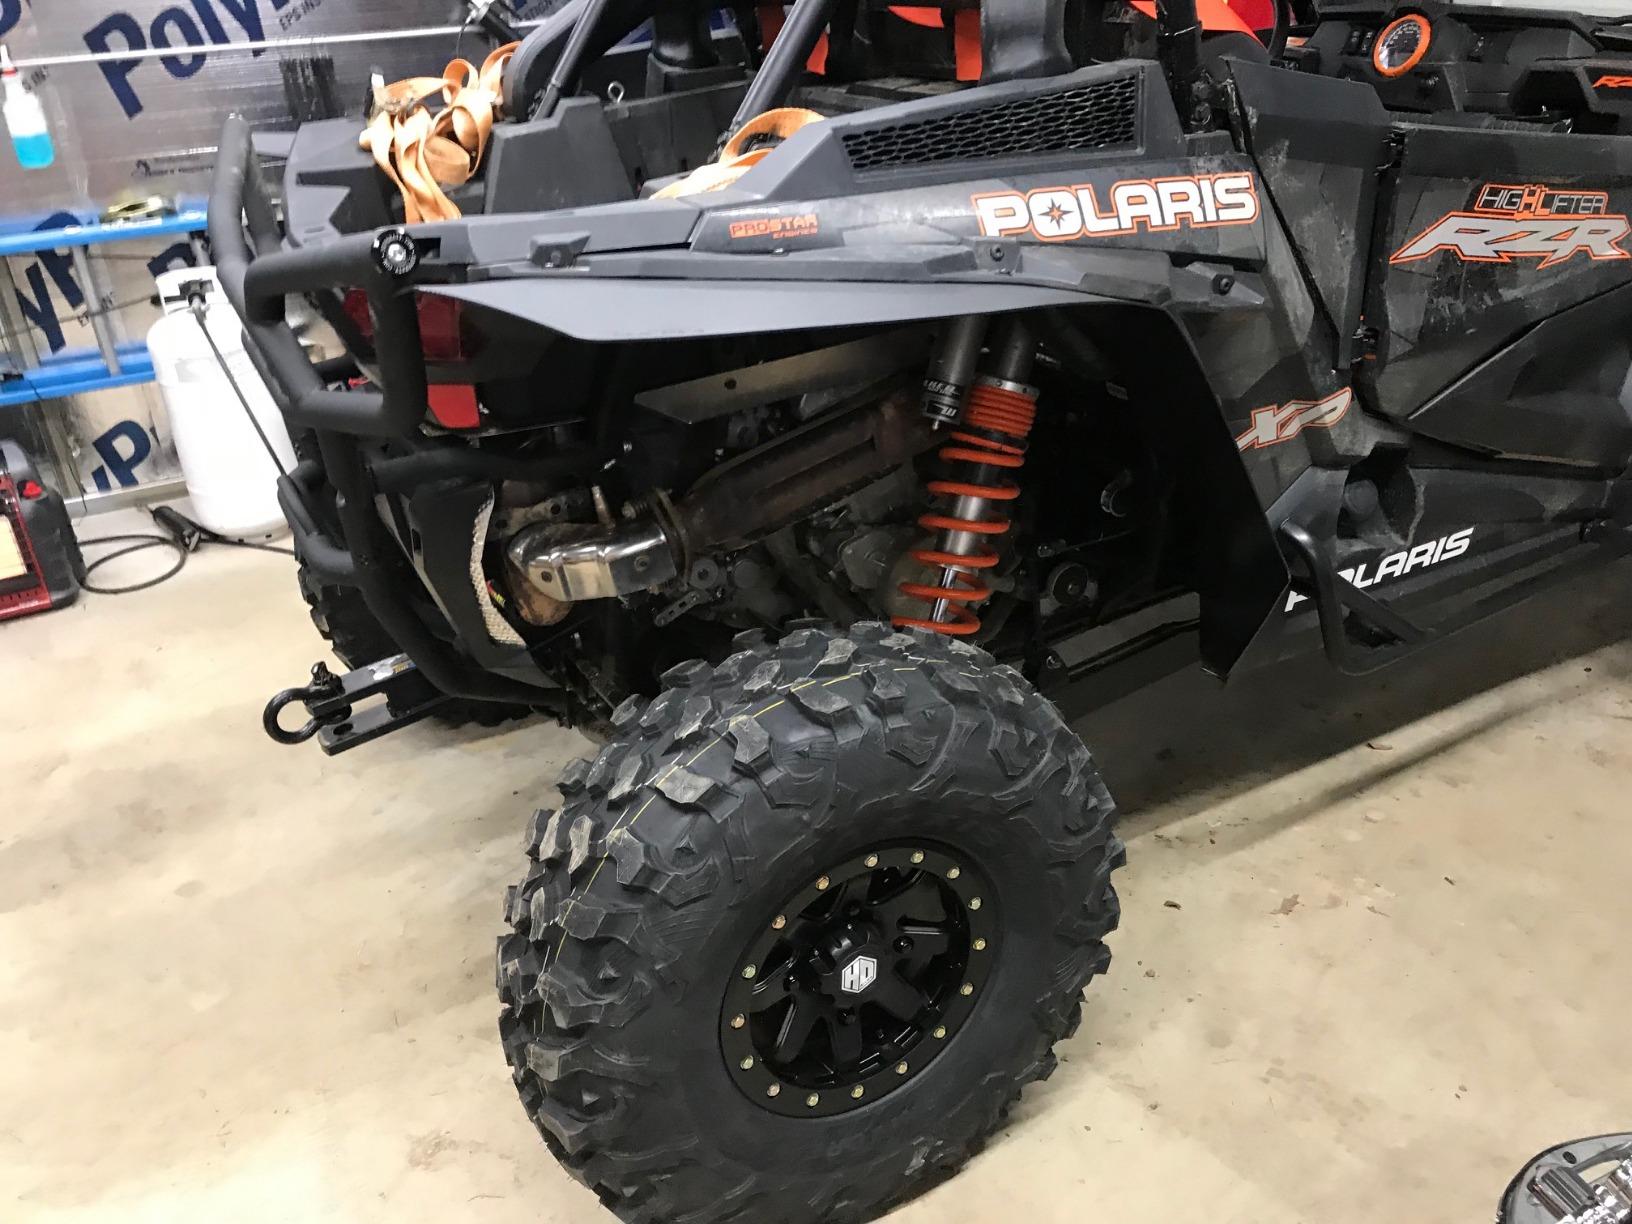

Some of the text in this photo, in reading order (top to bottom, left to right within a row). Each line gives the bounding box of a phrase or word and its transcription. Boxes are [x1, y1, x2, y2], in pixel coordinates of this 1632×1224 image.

[729, 213, 818, 238] PROSTAR
[973, 172, 1260, 242] POLARIS
[1391, 212, 1631, 269] RZR
[1236, 387, 1352, 450] XP
[842, 957, 876, 992] HD
